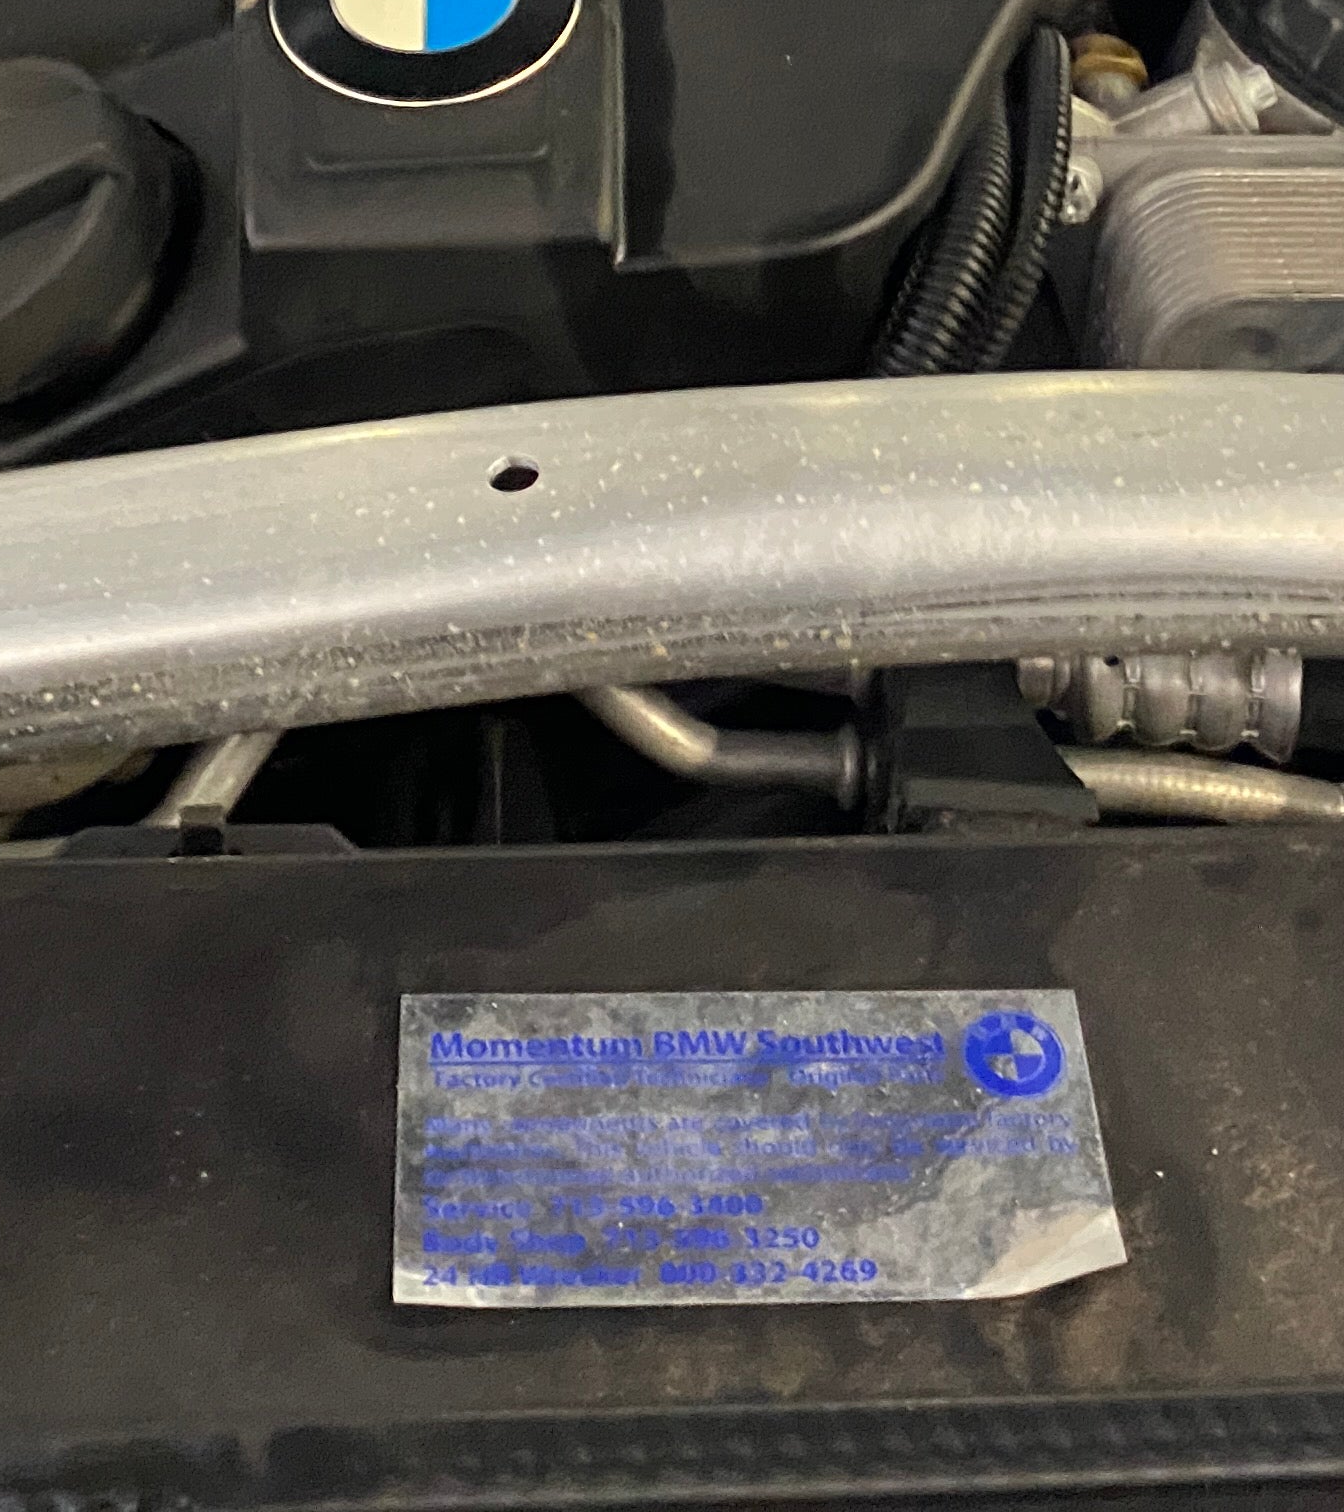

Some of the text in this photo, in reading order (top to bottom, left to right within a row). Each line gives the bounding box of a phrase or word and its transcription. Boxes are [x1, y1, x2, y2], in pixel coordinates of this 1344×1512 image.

[430, 1029, 945, 1059] Momentum BMW Southwest
